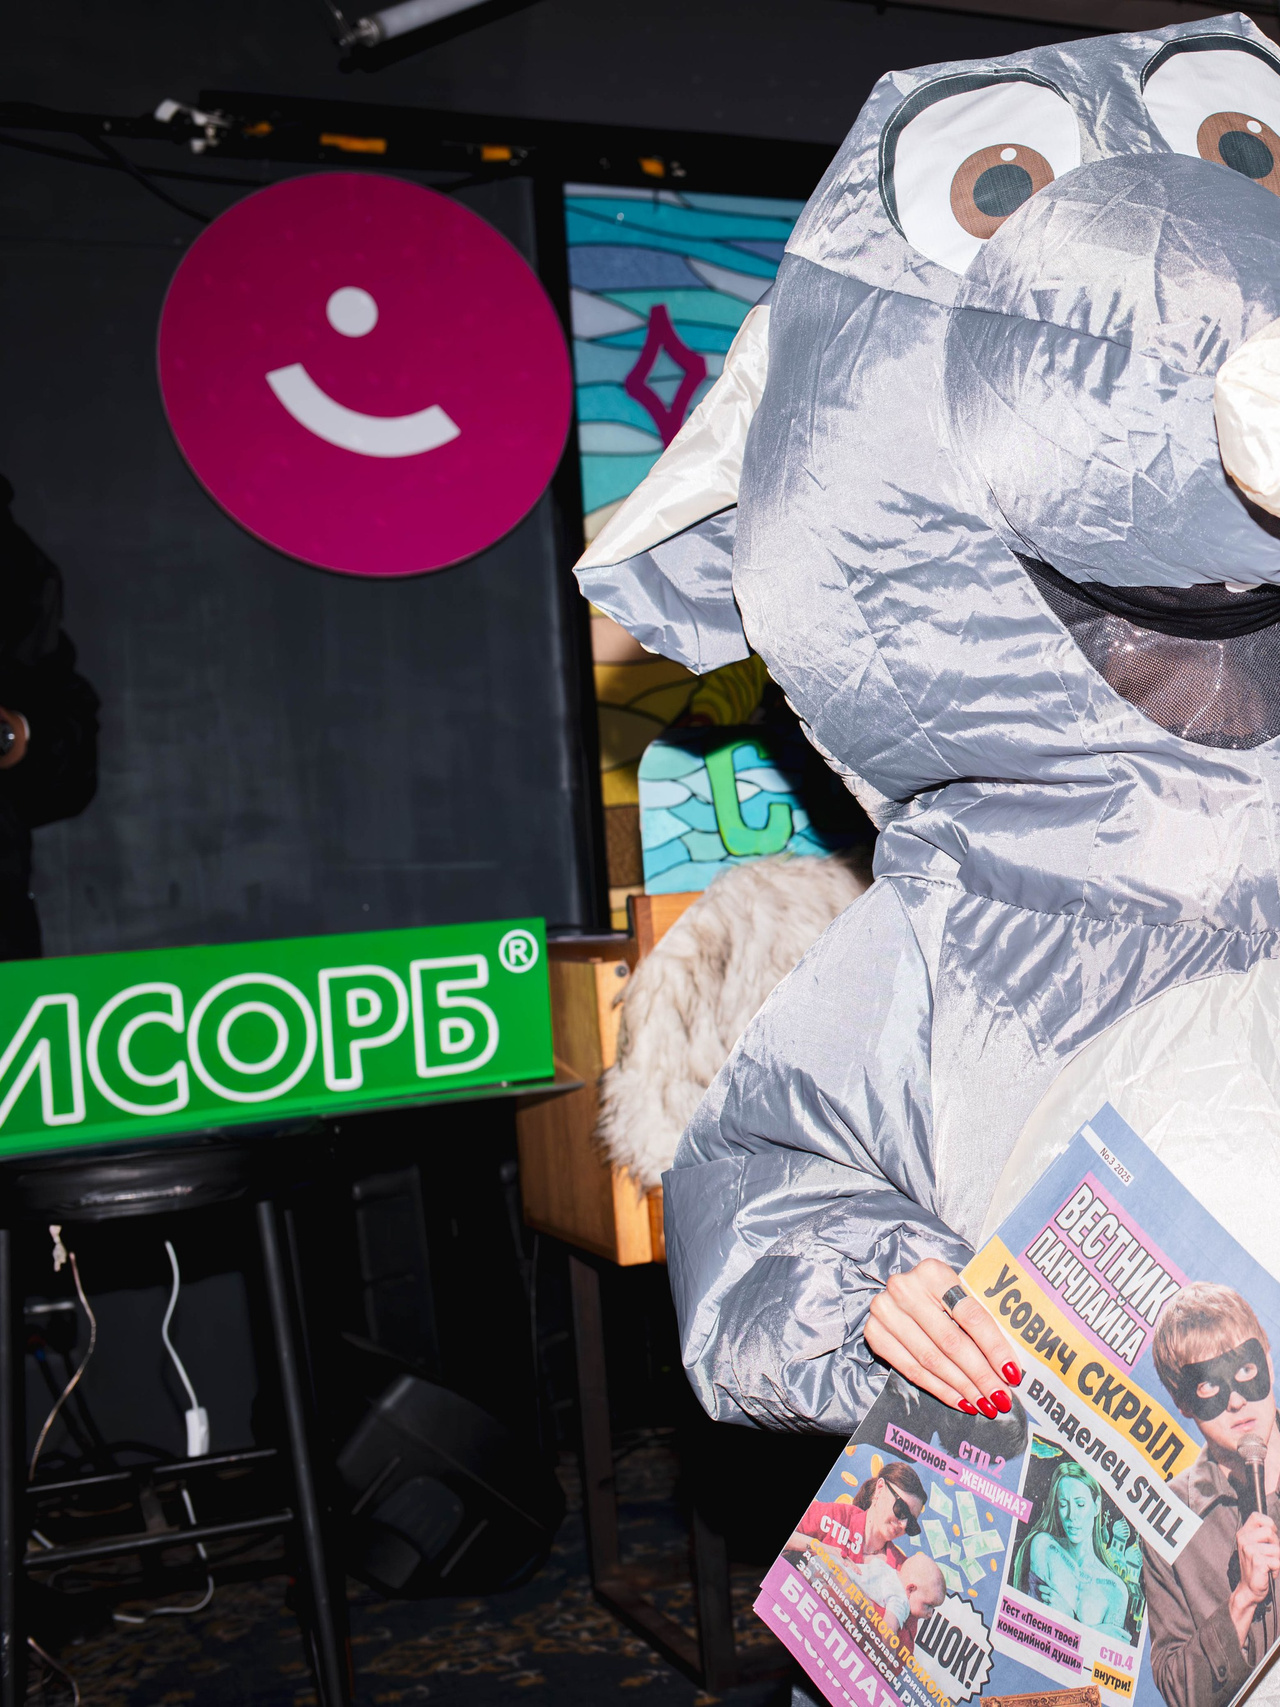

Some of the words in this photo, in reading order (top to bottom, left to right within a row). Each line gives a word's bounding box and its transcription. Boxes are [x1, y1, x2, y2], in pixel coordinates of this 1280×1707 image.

[1113, 1162, 1132, 1183] 2025
[1025, 1226, 1147, 1366] ПАНЧЛАЙНА
[1054, 1182, 1181, 1327] ВЕСТНИК
[984, 1263, 1077, 1375] Усович
[1077, 1361, 1185, 1483] СКРЫЛ,
[890, 1428, 946, 1471] Харитонов
[959, 1468, 1028, 1517] ЖЕНЩИНА?
[958, 1440, 1006, 1480] стр.2
[1027, 1378, 1130, 1491] владелец
[1126, 1475, 1184, 1548] STILL
[819, 1515, 862, 1555] стр.3
[796, 1559, 812, 1580] за
[811, 1579, 863, 1643] десятки
[863, 1641, 902, 1691] тысяч
[802, 1550, 859, 1618] доставшиеся
[859, 1616, 900, 1669] Ярославе
[900, 1666, 933, 1707] Тринад
[810, 1538, 848, 1586] Советы
[845, 1582, 900, 1649] ДЕТСКОГО
[898, 1645, 954, 1707] ПСИХОЛО
[915, 1609, 986, 1690] ШОК!
[997, 1619, 1051, 1655] комедийной
[1051, 1647, 1082, 1669] души»
[1094, 1668, 1131, 1692] внутри!
[1002, 1599, 1020, 1619] Тест
[1021, 1612, 1052, 1635] «Песня
[1054, 1629, 1080, 1649] твоей
[1099, 1646, 1134, 1672] стр.4
